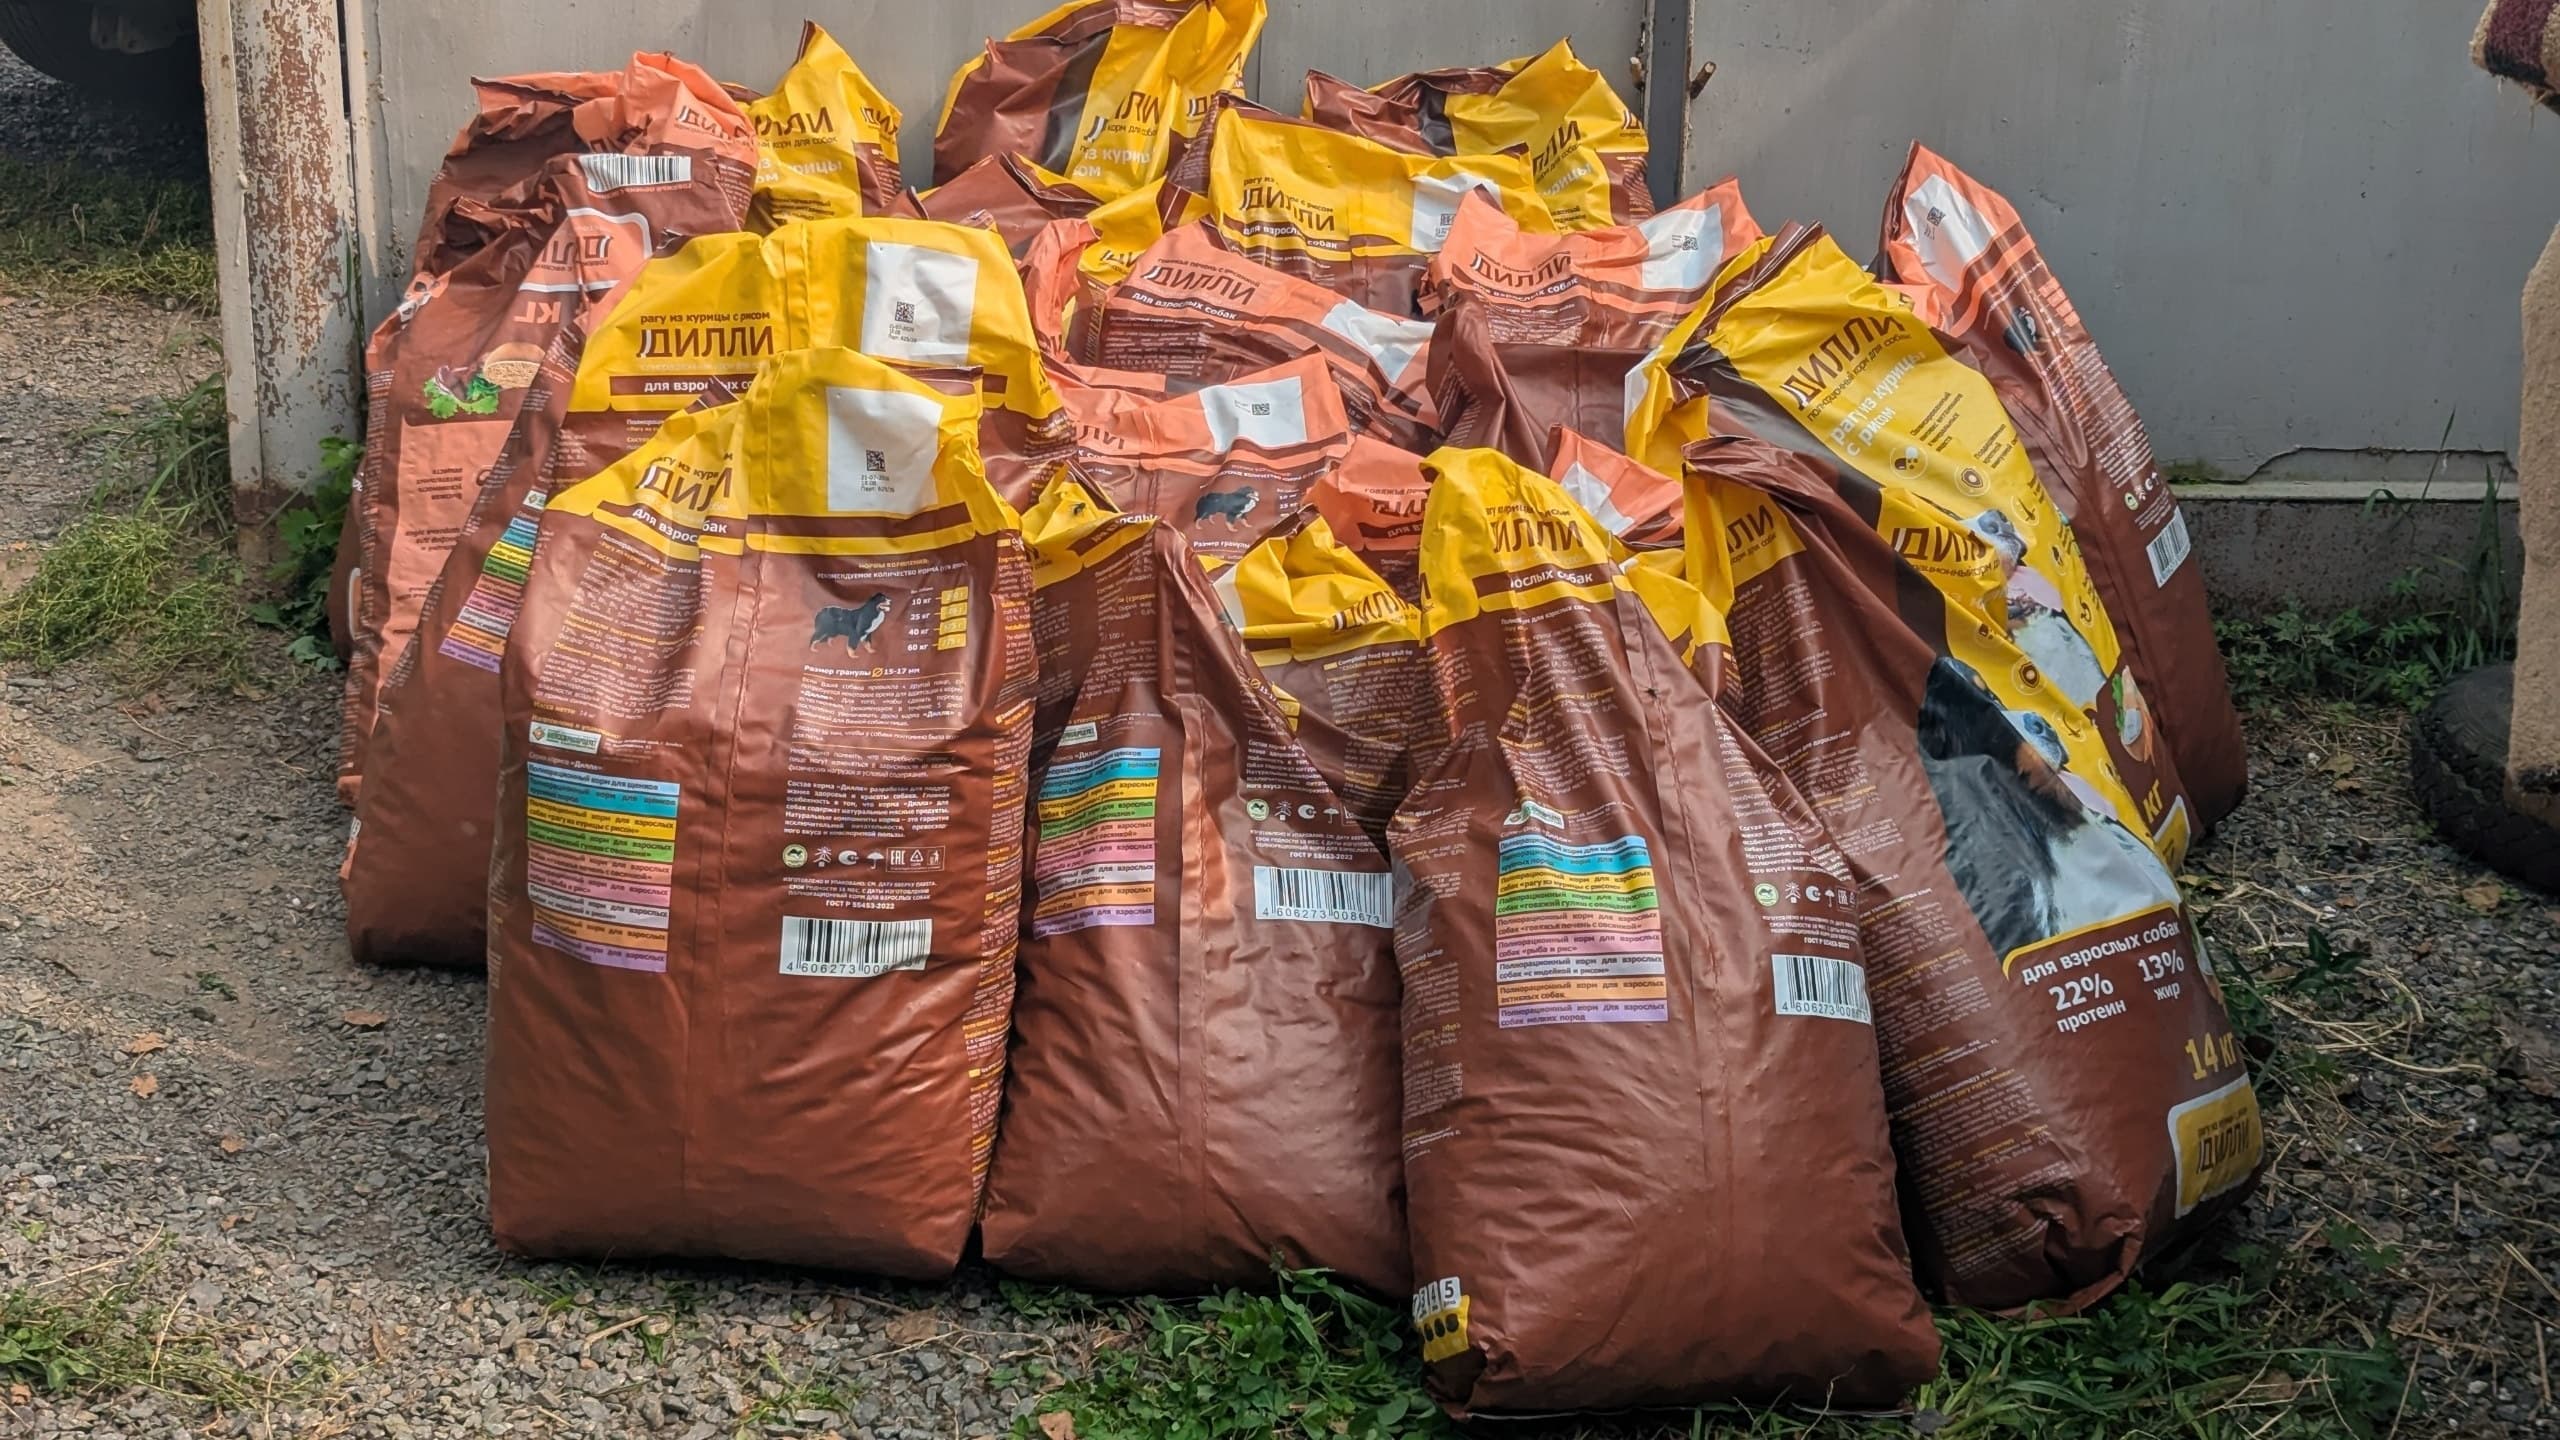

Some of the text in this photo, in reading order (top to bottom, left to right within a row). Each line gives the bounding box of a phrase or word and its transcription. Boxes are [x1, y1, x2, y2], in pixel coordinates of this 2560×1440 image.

[1469, 252, 1572, 288] ДИЛЛИ
[1140, 264, 1257, 306] ДИЛЛИ
[1131, 292, 1154, 305] для
[1204, 306, 1238, 320] собак
[640, 315, 667, 326] рагу
[669, 315, 684, 324] из
[686, 313, 731, 324] курицы
[636, 325, 774, 358] ДИЛЛИ
[1780, 315, 1907, 412] ДИЛЛИ
[644, 381, 670, 394] для
[1845, 440, 1862, 459] с
[632, 509, 729, 544] для взрос бак
[1492, 516, 1584, 555] ИЛЛИ
[911, 598, 922, 606] 10
[909, 612, 921, 621] 25
[908, 627, 919, 636] 40
[907, 642, 918, 652] 60
[804, 664, 834, 676] Размер
[1261, 907, 1381, 926] 4 606273 008673
[2021, 919, 2181, 992] для взрослых собак
[2136, 948, 2185, 985] 13%
[786, 962, 856, 975] 4 606273
[2047, 971, 2115, 1015] 22%
[2153, 981, 2182, 1004] жир
[1781, 1002, 1836, 1016] 4 606273
[2055, 998, 2128, 1035] протеин
[2184, 1031, 2220, 1082] 14
[1444, 1280, 1455, 1300] 5
